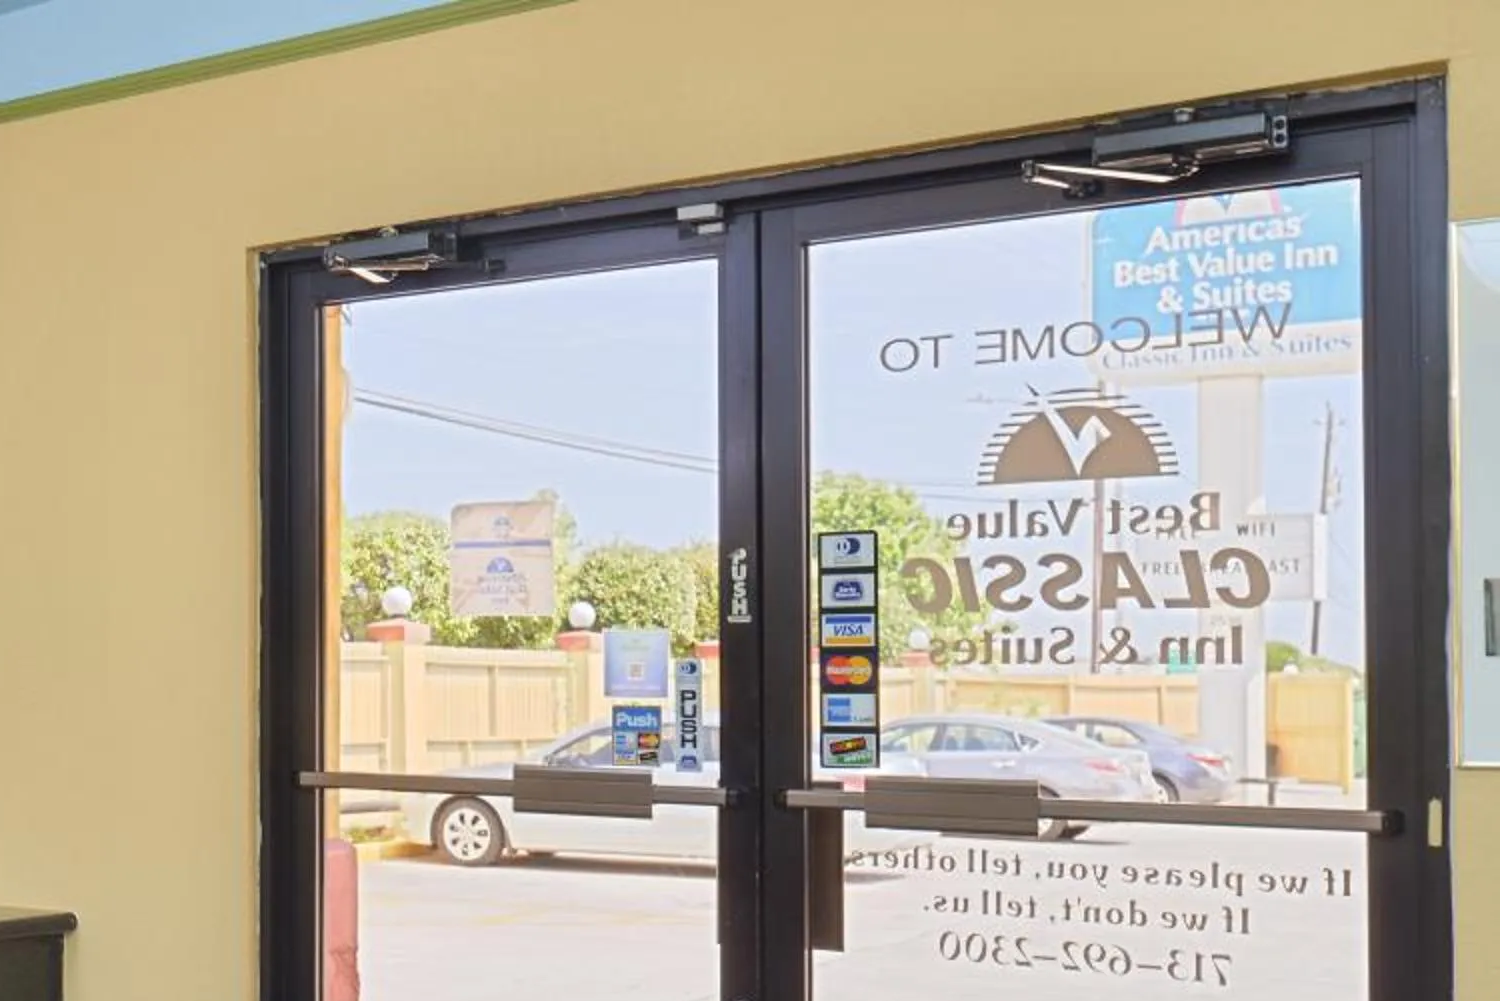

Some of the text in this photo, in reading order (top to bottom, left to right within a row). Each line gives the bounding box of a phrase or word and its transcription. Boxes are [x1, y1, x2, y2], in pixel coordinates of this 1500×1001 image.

[1113, 242, 1339, 288] Best Value Inn
[1157, 277, 1293, 315] & Suites
[1101, 349, 1180, 371] Classic
[1270, 333, 1353, 354] Suites
[1236, 521, 1277, 537] WIFI
[730, 547, 748, 615] PUSH
[833, 623, 864, 637] VISA
[615, 711, 659, 729] Push
[681, 689, 697, 749] PUSH
